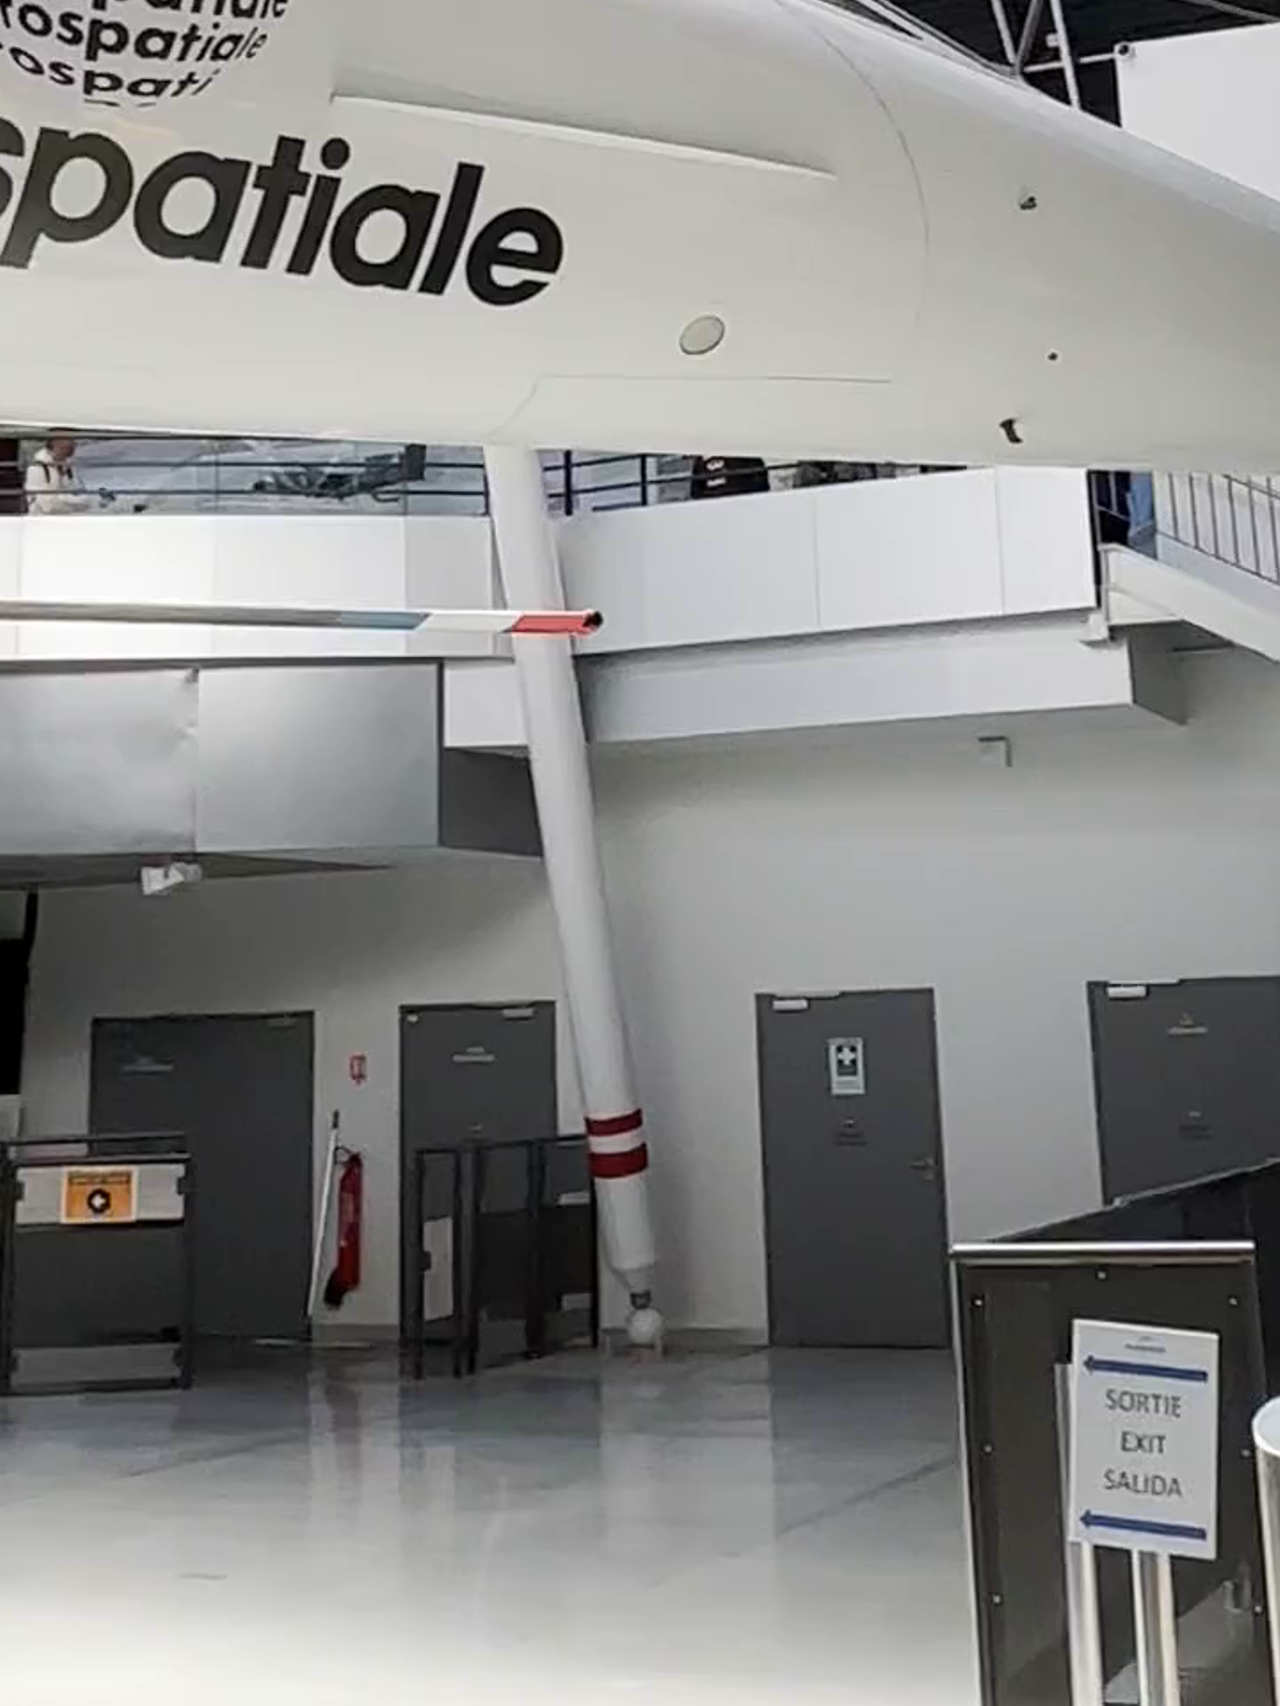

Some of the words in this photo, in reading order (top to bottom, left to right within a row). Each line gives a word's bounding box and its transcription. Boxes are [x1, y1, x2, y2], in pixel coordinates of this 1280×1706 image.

[1105, 1387, 1182, 1419] SORTIE
[1120, 1431, 1167, 1454] EXIT
[1103, 1468, 1183, 1498] SALIDA
